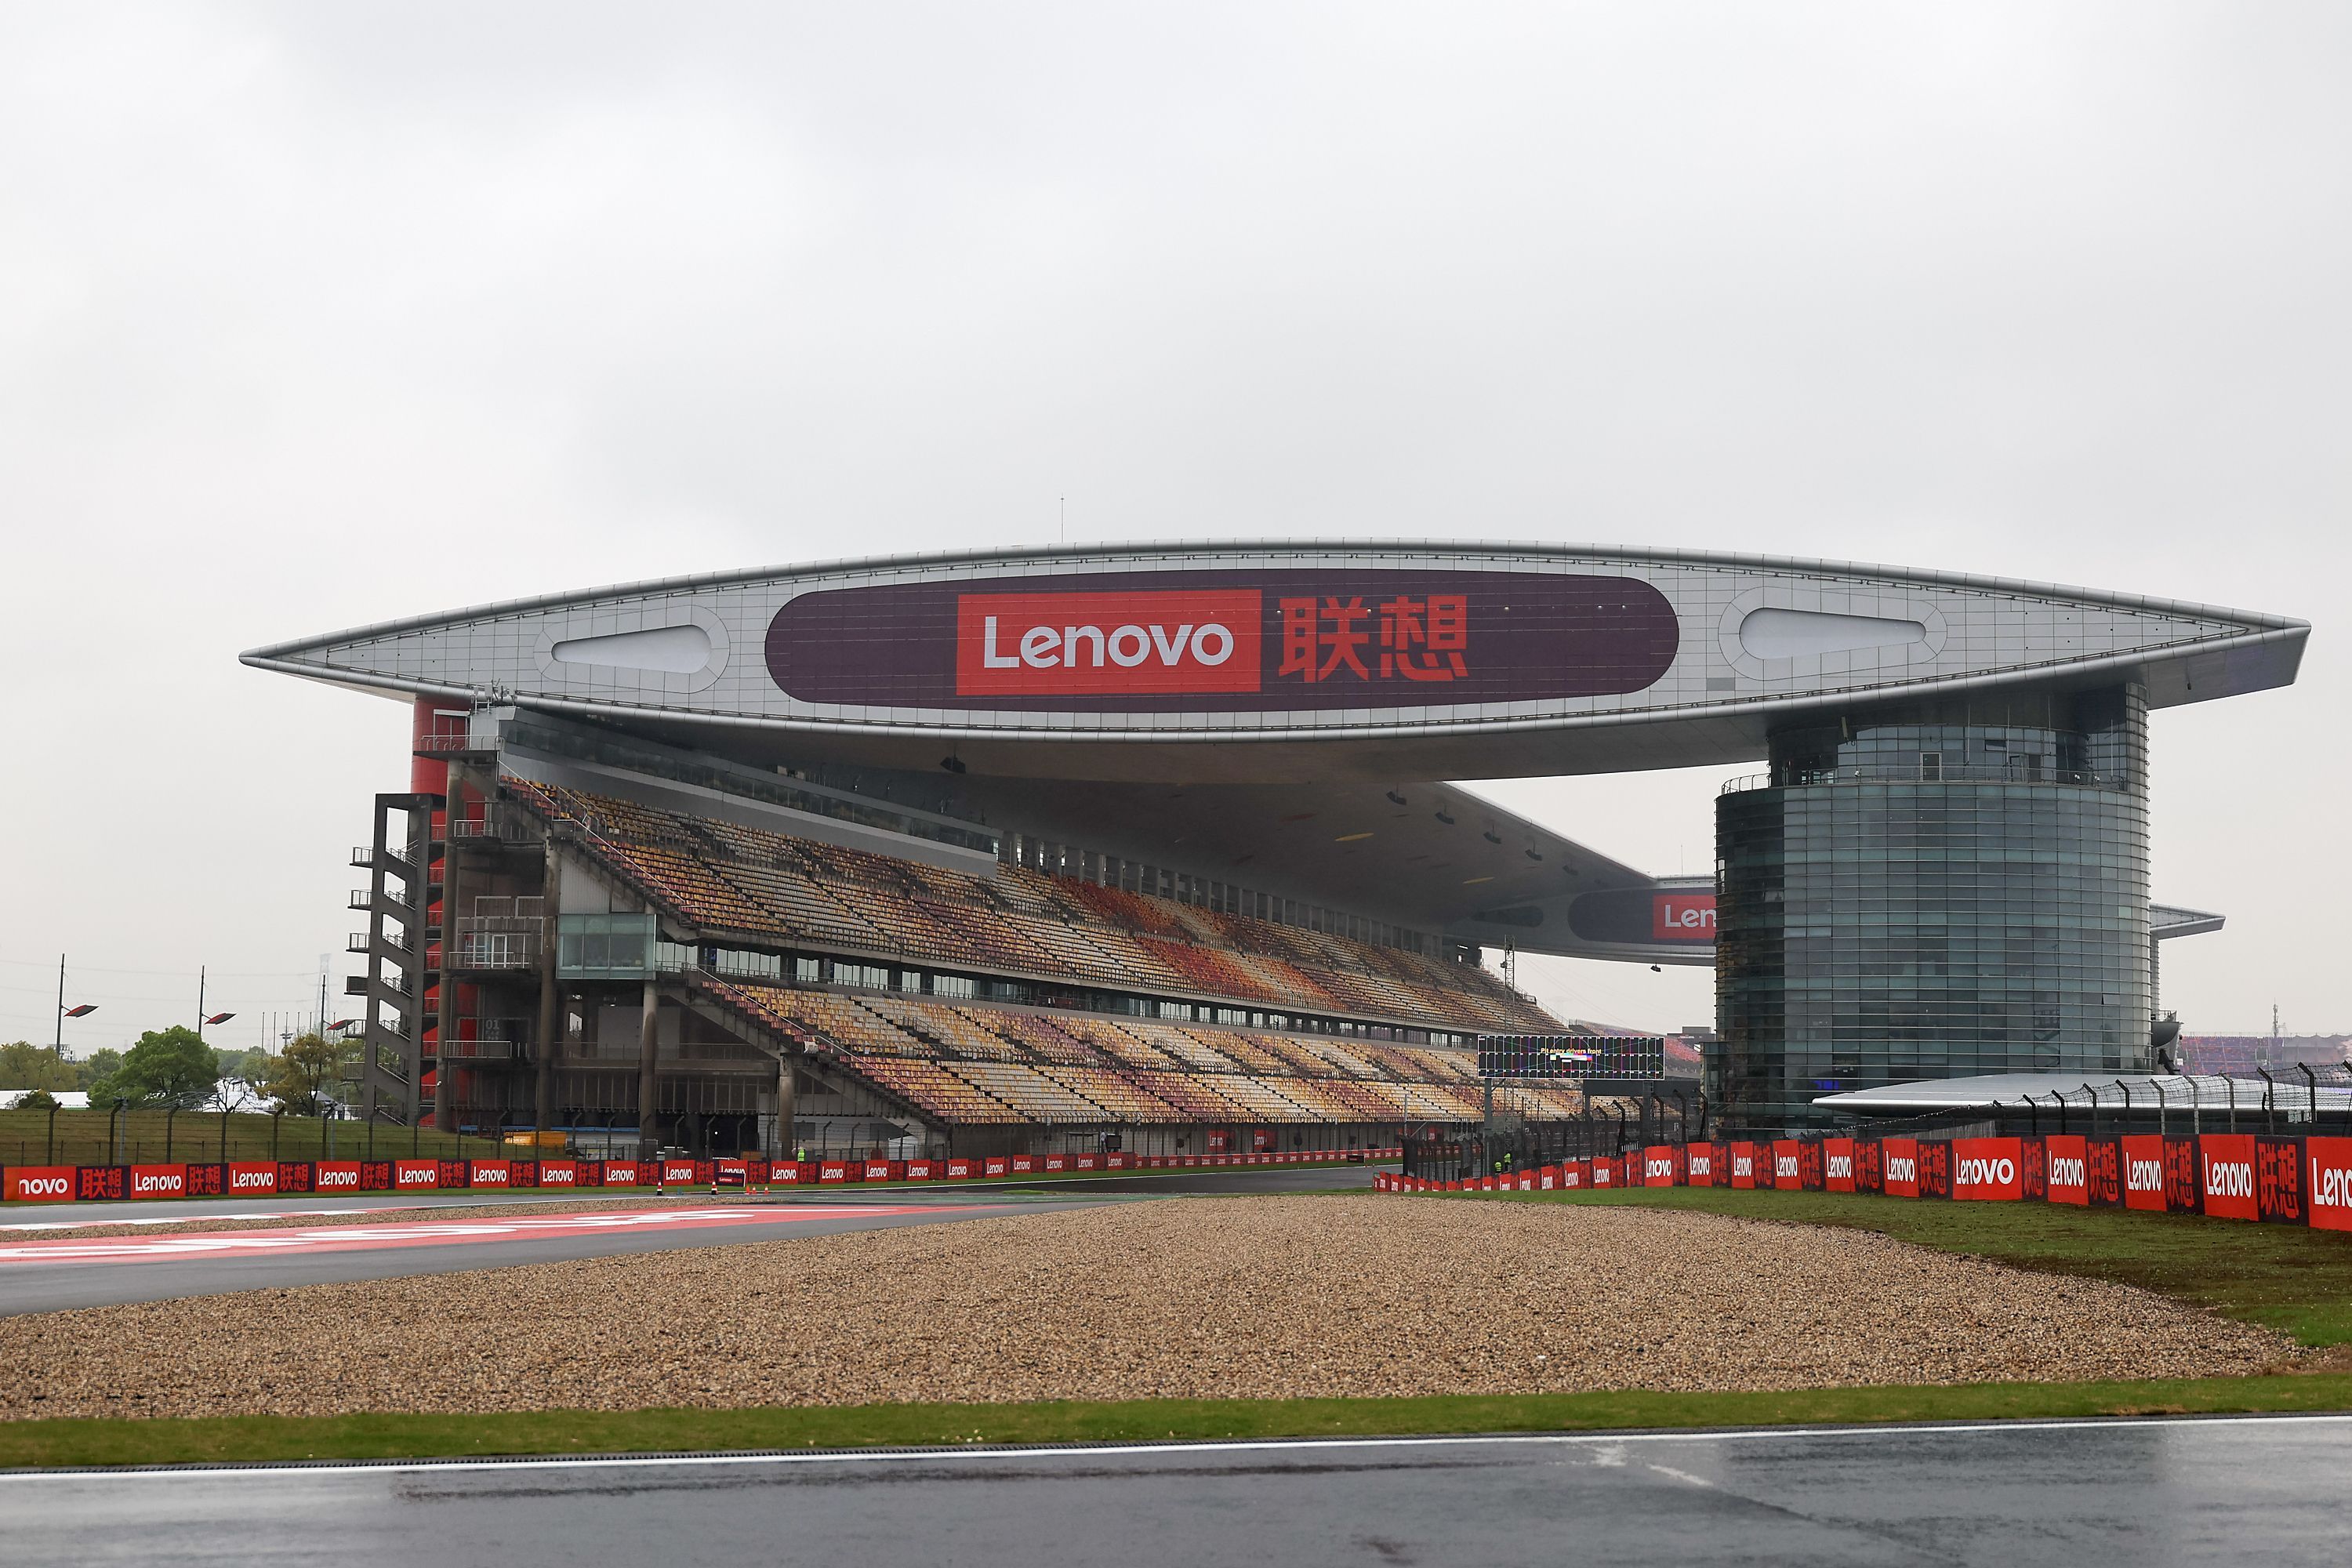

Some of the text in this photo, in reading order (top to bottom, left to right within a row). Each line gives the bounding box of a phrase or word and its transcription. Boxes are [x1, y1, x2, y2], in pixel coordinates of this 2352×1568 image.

[984, 595, 1468, 681] Lenovo 联想
[1665, 904, 1716, 927] Len
[666, 1167, 692, 1180] Lenovo
[772, 1167, 797, 1180] Lenovo
[822, 1167, 844, 1179] Lenovo
[866, 1165, 887, 1178] Lenovo
[909, 1164, 928, 1177] Lenovo
[949, 1164, 967, 1176] Lenovo
[986, 1163, 1004, 1174] Lenovo
[1014, 1159, 1030, 1171] Lenovo
[1047, 1158, 1062, 1169] Lenovo
[1078, 1157, 1093, 1167] Lenovo
[1646, 1156, 1672, 1178] Lenovo
[1690, 1152, 1710, 1175] Lenovo
[1733, 1152, 1752, 1177] Lenovo
[1775, 1151, 1797, 1178] Lenovo
[1826, 1144, 1879, 1189] Lenovo 联想
[1886, 1145, 1947, 1196] Lenovo 联想
[1955, 1142, 2044, 1196] Lenovo 联想
[2049, 1143, 2118, 1202] Lenovo 联想
[20, 1168, 122, 1199] novo 联想
[136, 1166, 221, 1194] Lenovo 联想
[233, 1164, 309, 1190] Lenovo 联想
[318, 1163, 389, 1189] Lenovo 联想
[399, 1163, 464, 1187] Lenovo 联想
[473, 1163, 534, 1185] Lenovo 联想
[543, 1163, 599, 1186] Lenovo 联想
[606, 1167, 634, 1181] Lenovo
[1565, 1170, 1579, 1187] Lenovo
[1594, 1166, 1610, 1183] Lenovo
[2125, 1142, 2194, 1208] Lenovo 联想
[2204, 1143, 2299, 1220] Lenovo 联想
[2313, 1157, 2352, 1208] Leno
